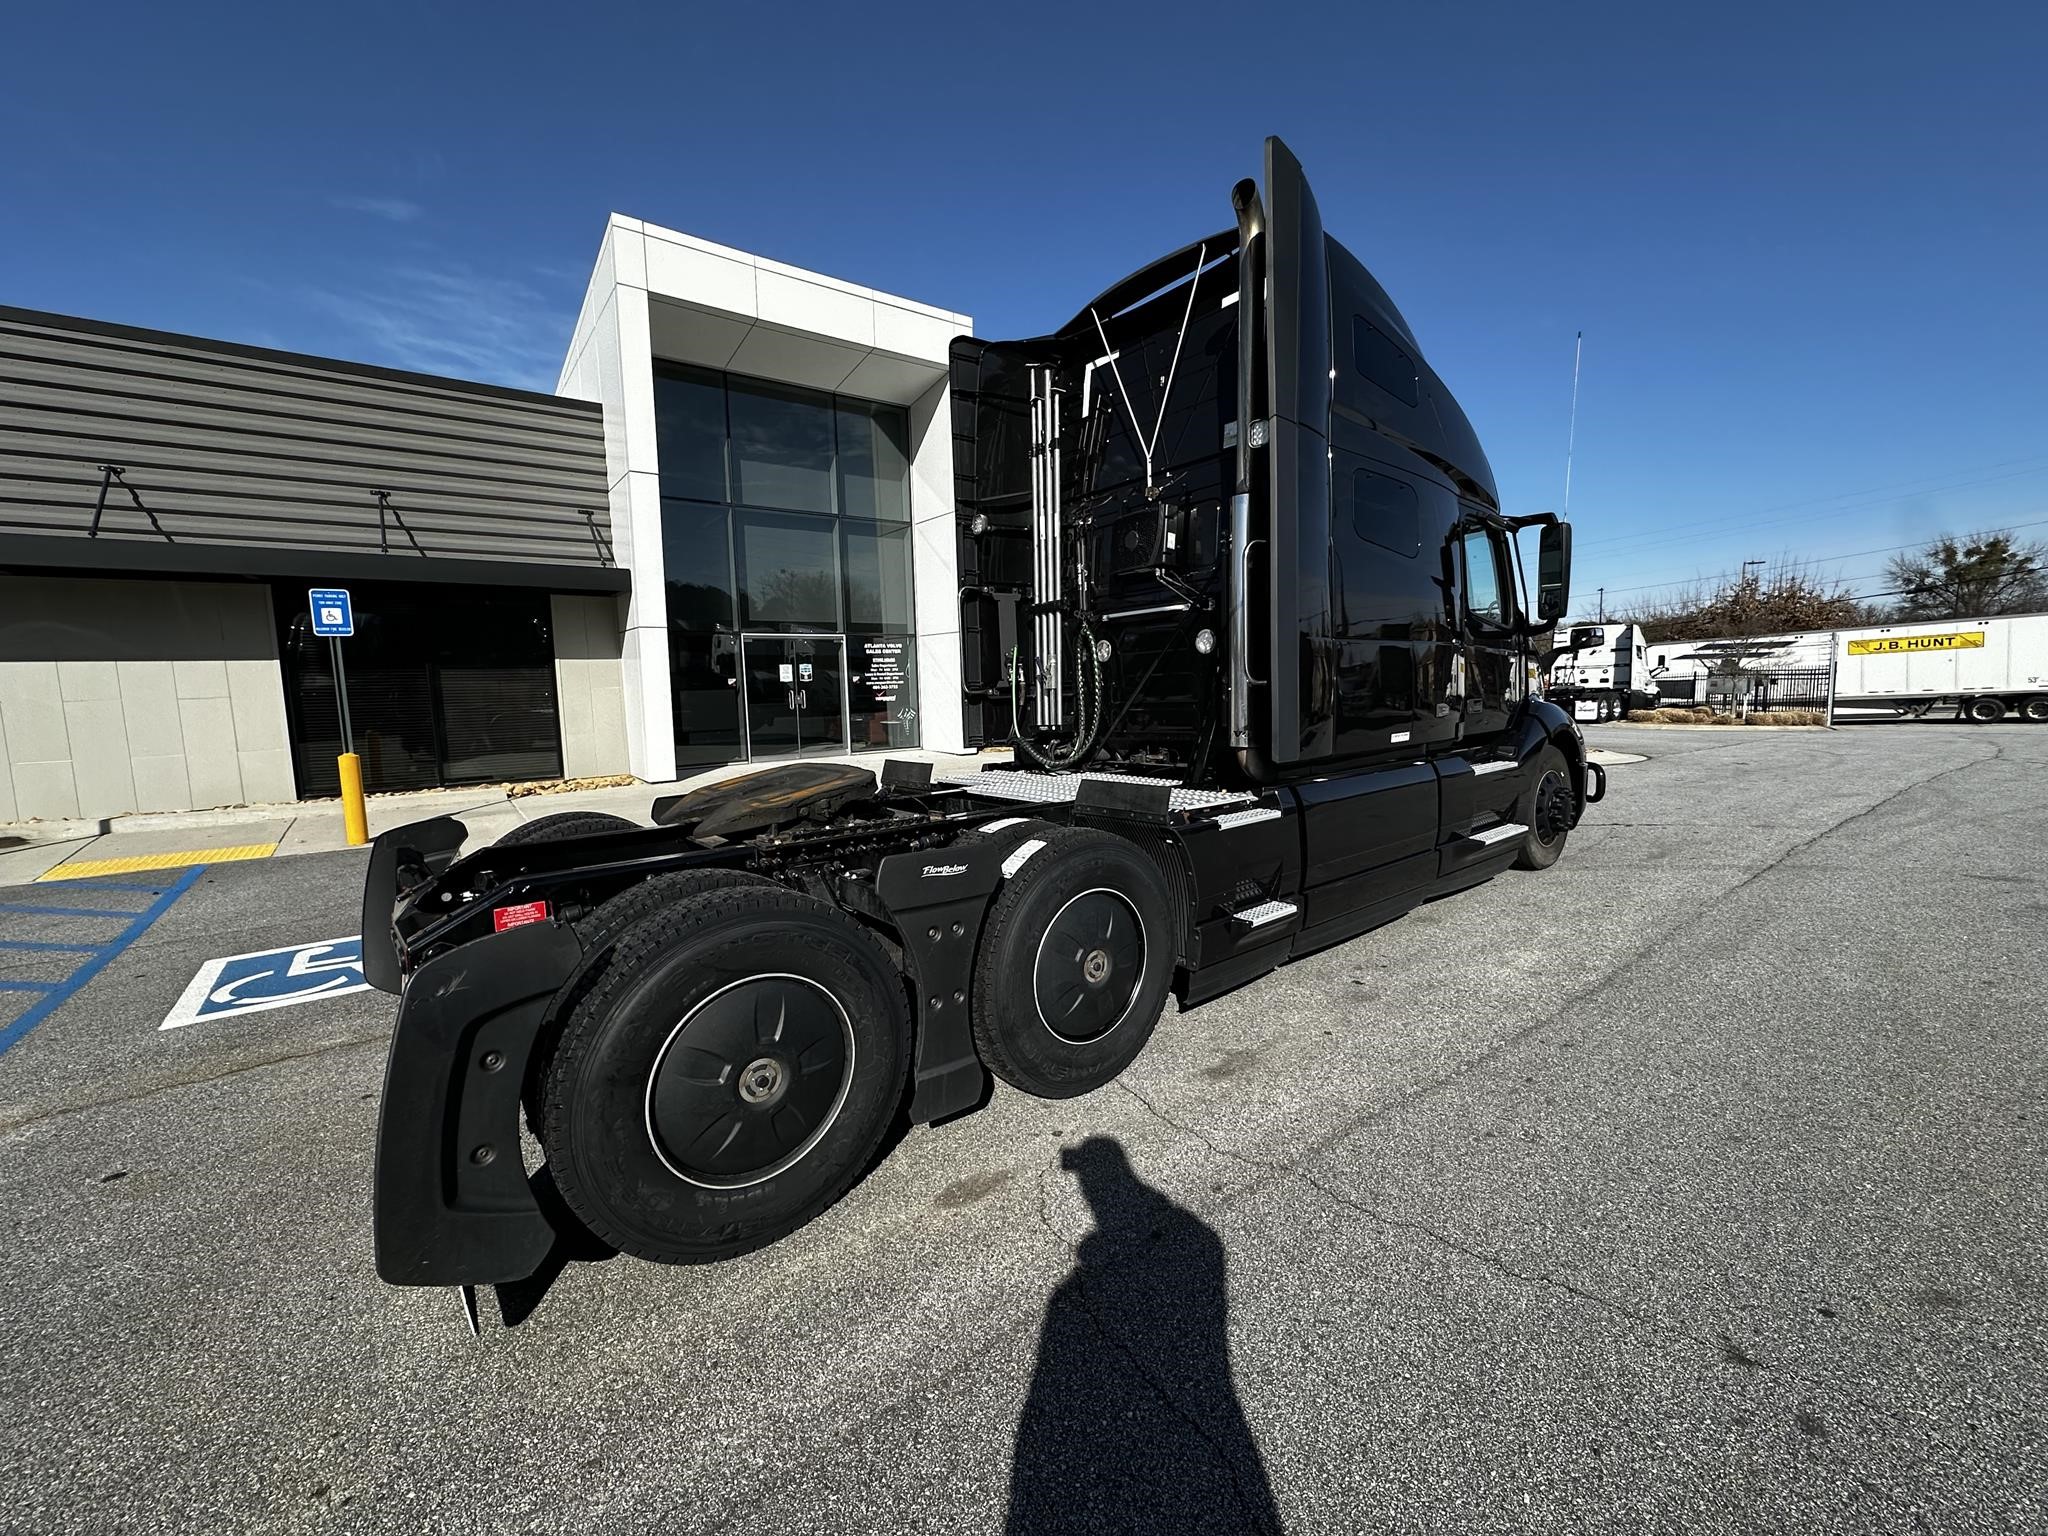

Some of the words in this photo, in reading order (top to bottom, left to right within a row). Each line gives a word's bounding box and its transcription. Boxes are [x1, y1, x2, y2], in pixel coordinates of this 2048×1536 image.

[1873, 641, 1903, 651] J.B.
[1907, 637, 1956, 649] HUNT
[921, 863, 969, 877] FlowBelow
